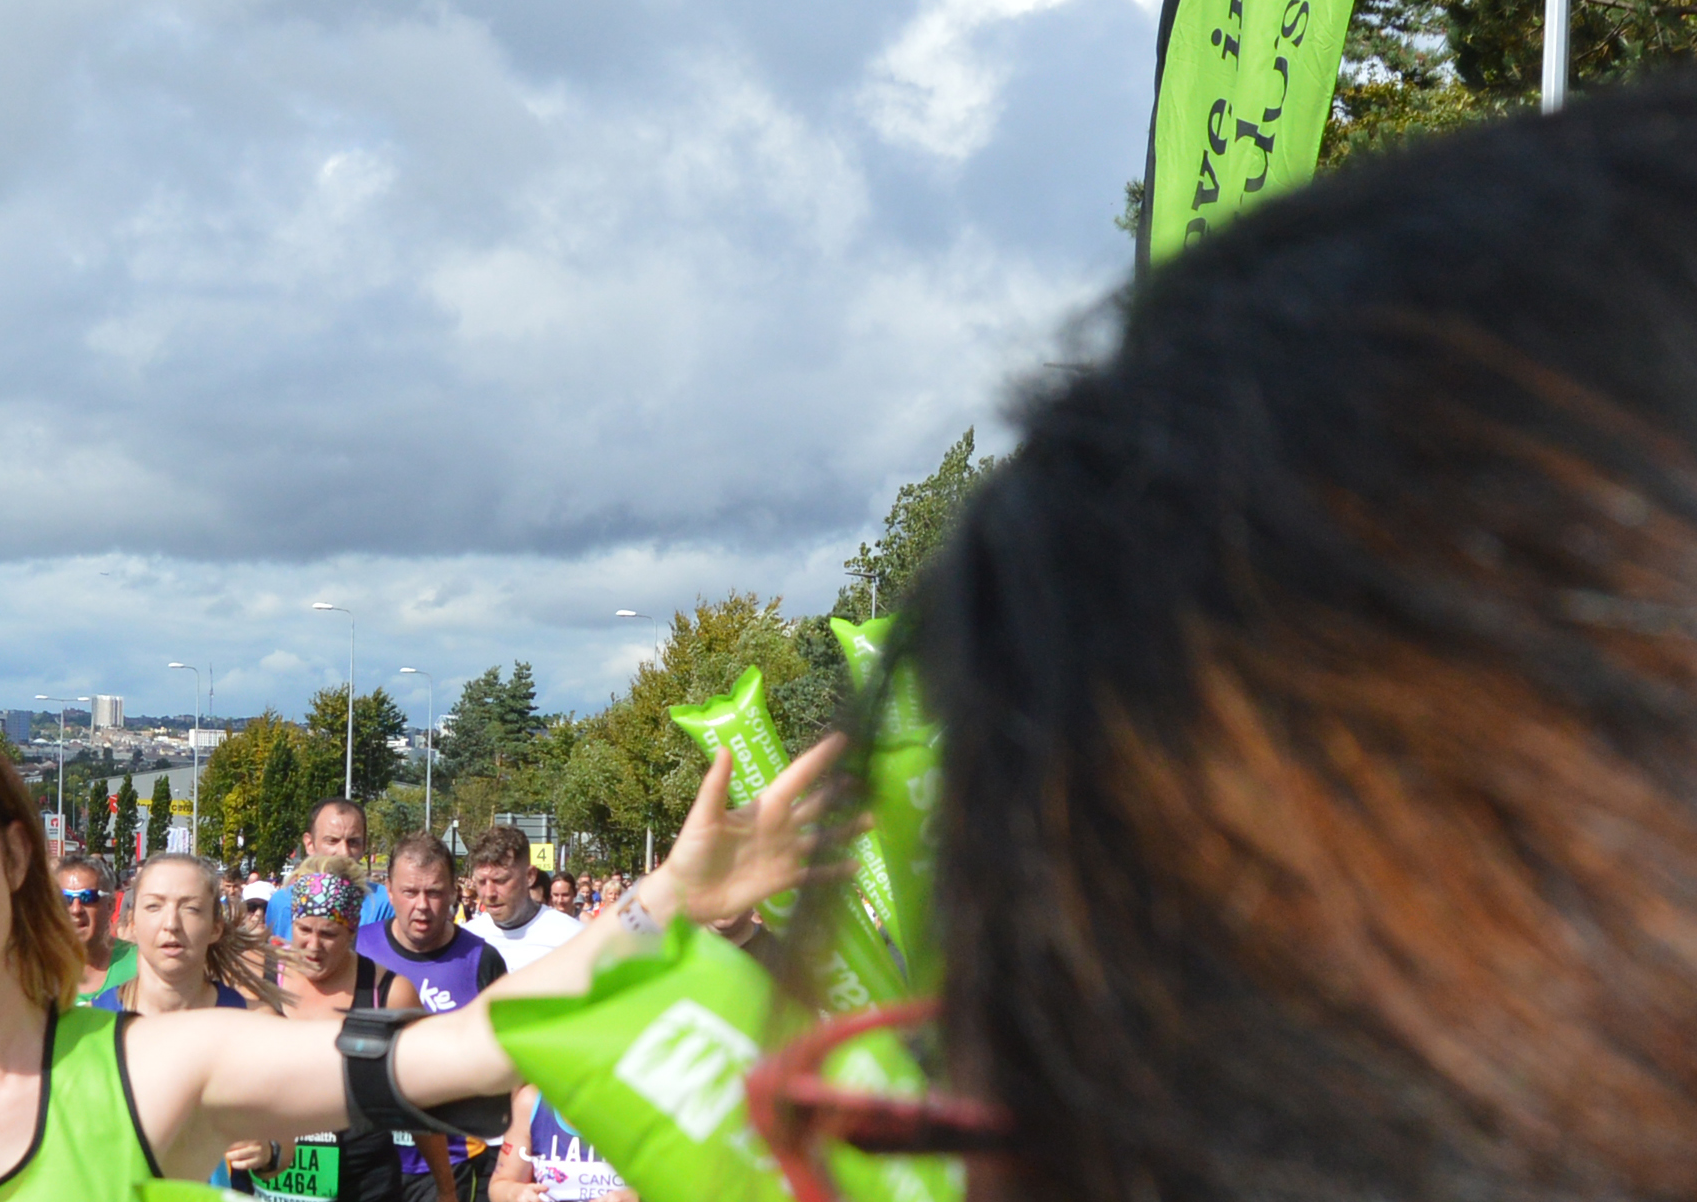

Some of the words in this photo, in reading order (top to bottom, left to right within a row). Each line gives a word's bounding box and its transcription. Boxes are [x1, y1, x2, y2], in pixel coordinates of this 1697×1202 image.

[745, 705, 787, 775] nardo's
[729, 733, 769, 799] ldren
[537, 848, 547, 863] 4
[578, 1173, 627, 1188] CANC
